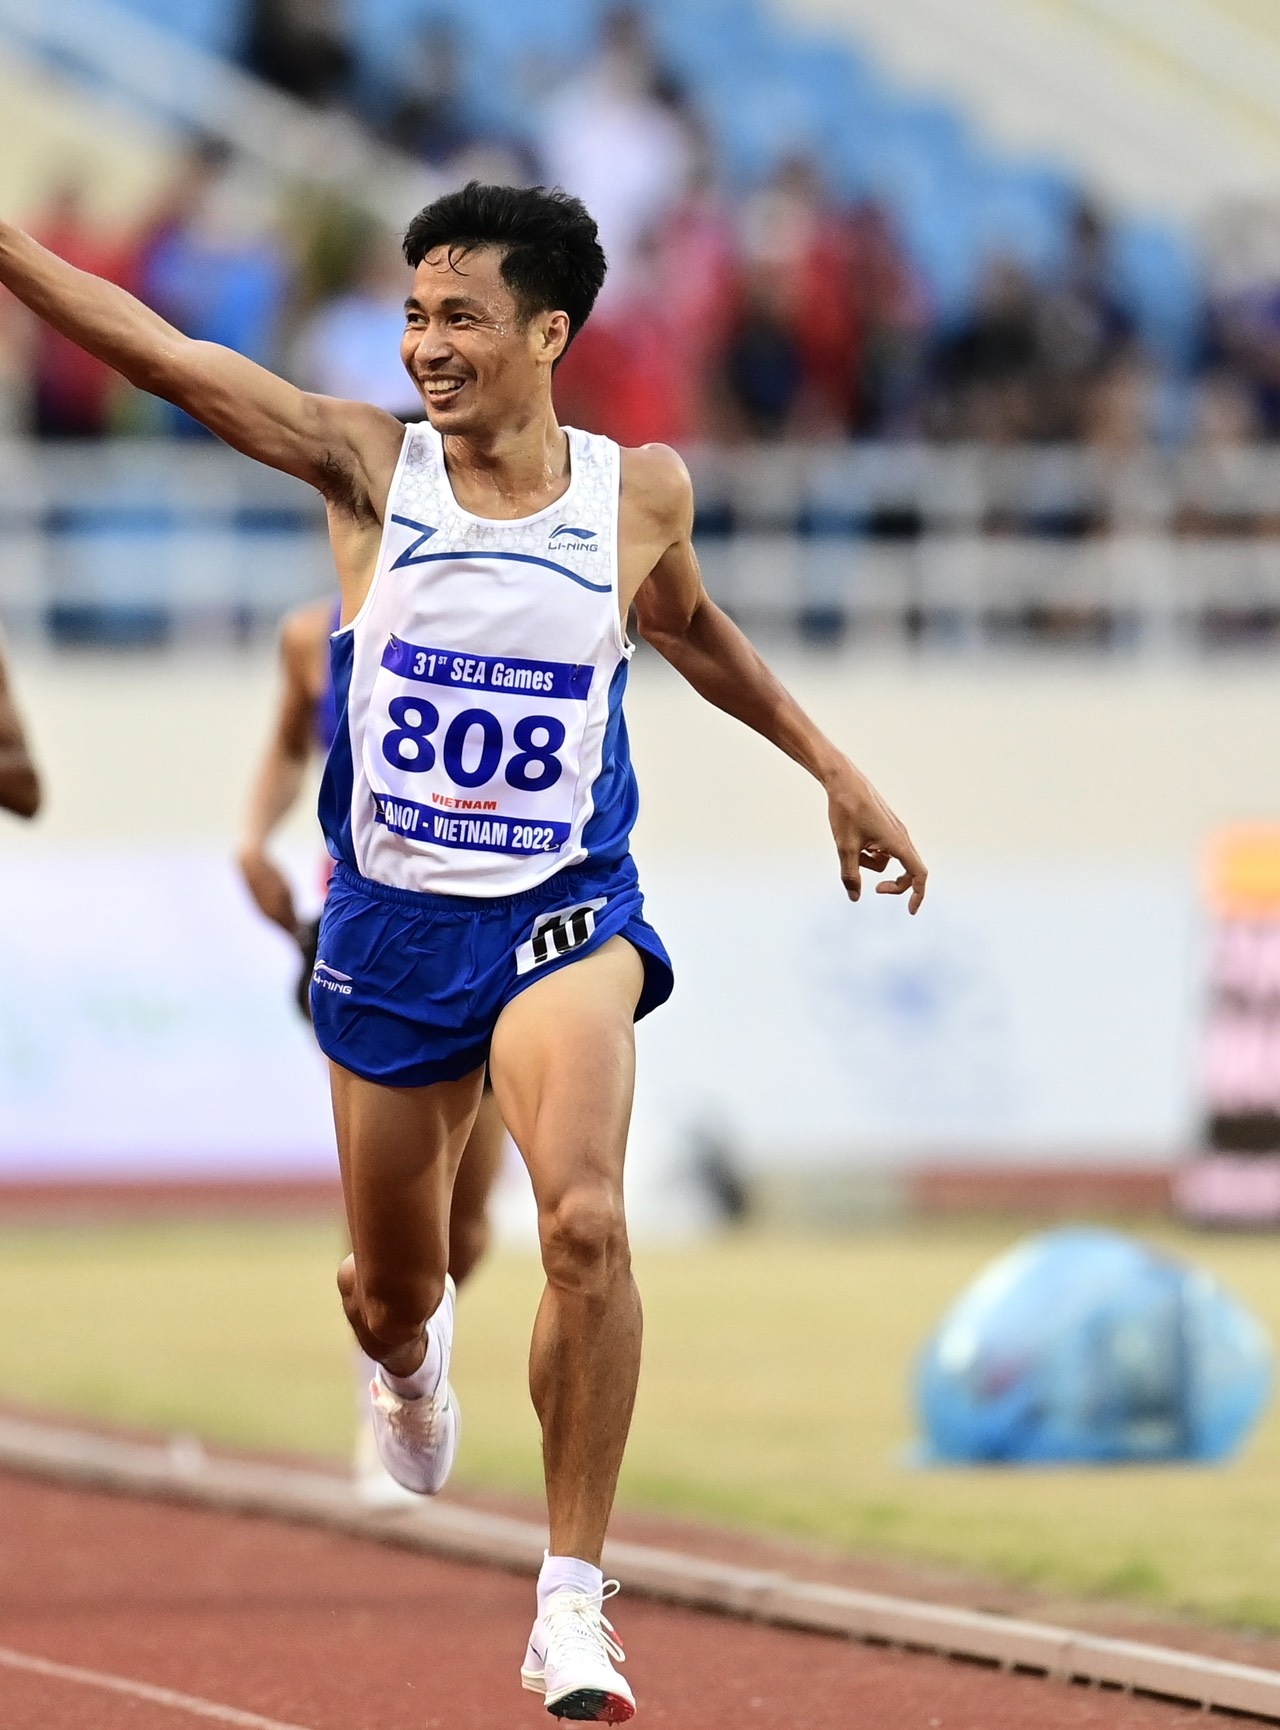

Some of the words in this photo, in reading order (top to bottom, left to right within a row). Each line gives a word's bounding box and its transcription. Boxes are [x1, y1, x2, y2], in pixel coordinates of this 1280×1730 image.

[548, 542, 598, 552] LI-NING
[450, 657, 486, 684] SEA
[491, 662, 554, 691] Games
[382, 696, 566, 792] 808
[432, 792, 497, 811] VIETNAM
[433, 815, 508, 847] VIETNAM
[511, 825, 554, 850] 2022
[313, 971, 353, 995] LI-NING
